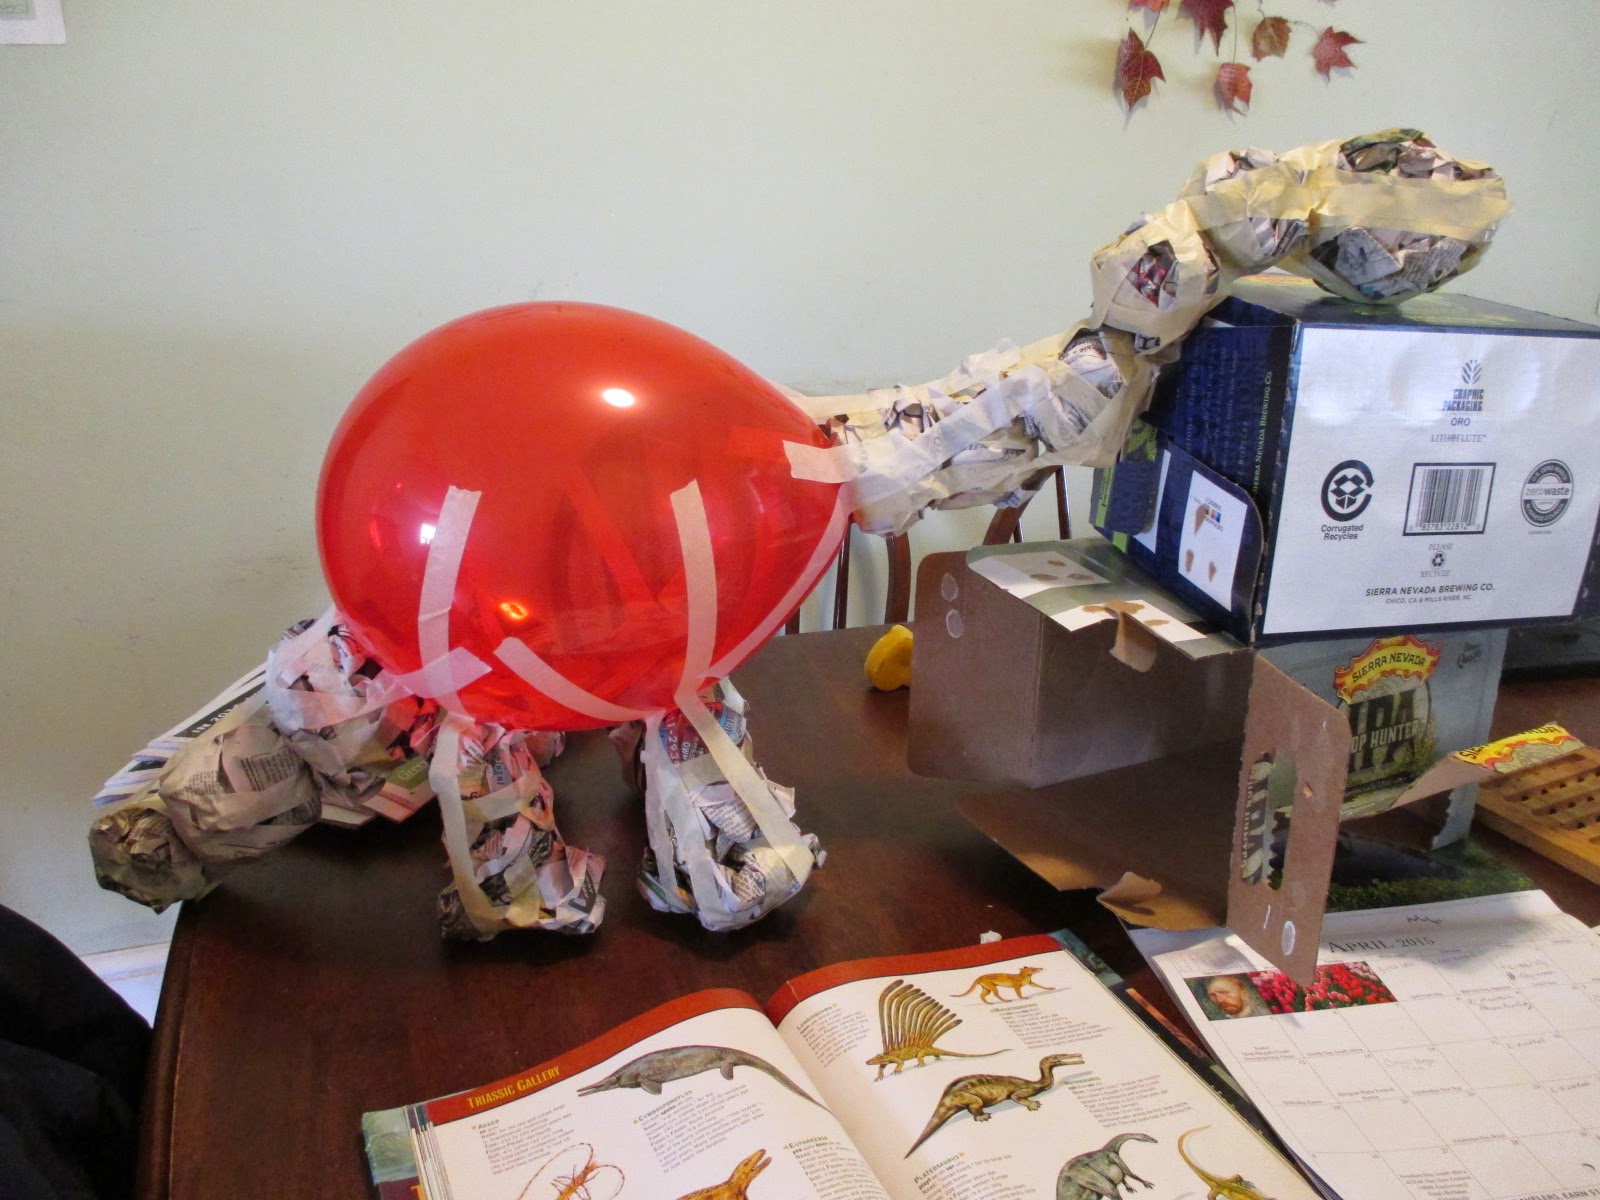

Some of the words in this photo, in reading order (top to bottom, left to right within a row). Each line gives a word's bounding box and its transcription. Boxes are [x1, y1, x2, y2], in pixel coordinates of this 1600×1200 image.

[1260, 387, 1271, 427] BREWING
[1450, 417, 1471, 427] ORO
[1256, 429, 1267, 463] NEVADA
[1252, 465, 1262, 493] SIERRA
[1321, 524, 1364, 533] Corrugated
[1324, 532, 1358, 541] Recycles
[1429, 543, 1453, 551] PLEASE
[1365, 587, 1397, 596] SIERRA
[1400, 586, 1436, 595] NEVADA
[1438, 583, 1478, 593] BREWING
[1352, 656, 1387, 683] SIERRA
[1389, 652, 1425, 667] NEVADA
[1370, 719, 1419, 748] HUNTER
[1328, 939, 1394, 953] APRIL
[467, 1085, 516, 1109] TRIASSIC
[517, 1066, 560, 1091] GALLERY
